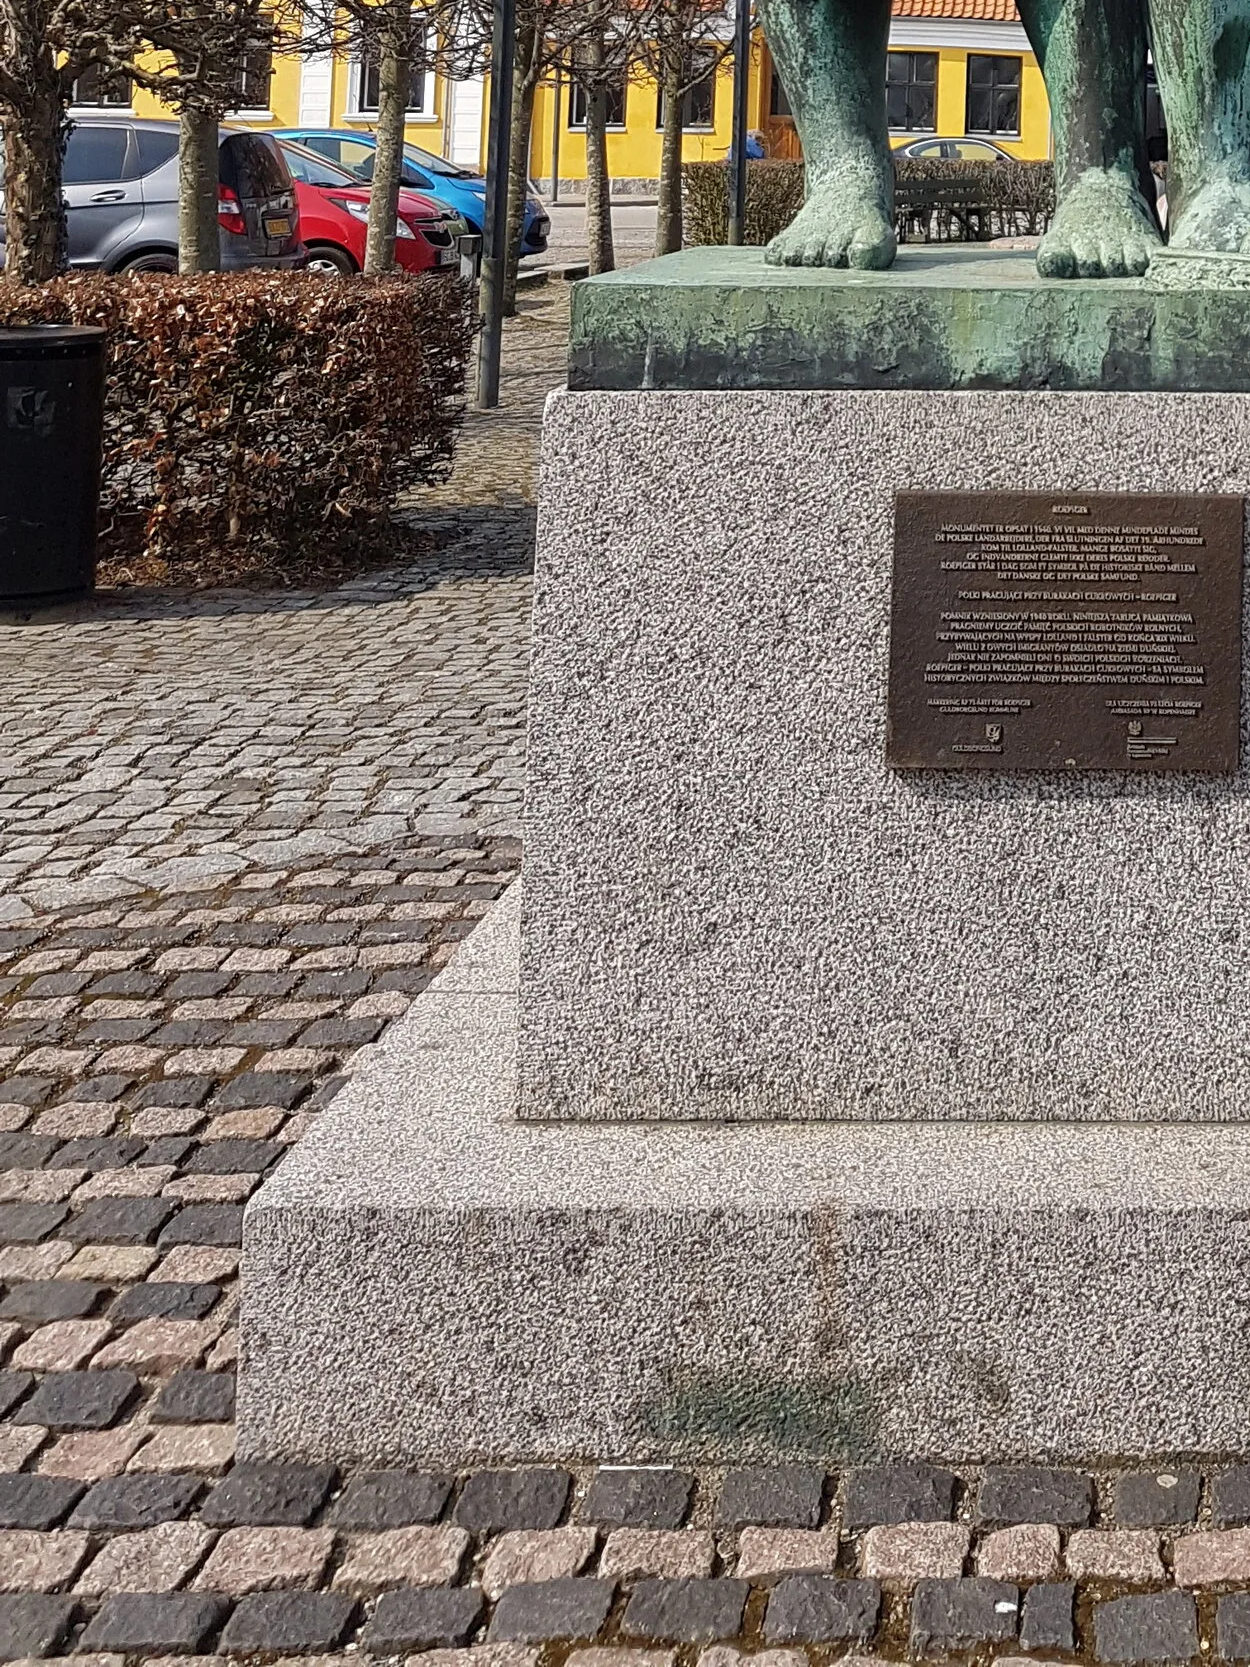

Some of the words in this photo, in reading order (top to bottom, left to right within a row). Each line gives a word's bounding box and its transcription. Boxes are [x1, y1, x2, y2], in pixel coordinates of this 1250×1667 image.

[941, 524, 994, 532] MONUMENTET
[1095, 526, 1120, 534] DENNE
[1170, 527, 1198, 535] MINDES
[1036, 535, 1050, 543] DER
[1126, 536, 1139, 544] DET
[1080, 545, 1108, 553] MANGE
[1110, 554, 1136, 562] POLSKE
[978, 561, 996, 570] STÅR
[1145, 563, 1166, 572] BÅND
[959, 591, 980, 599] POLKI
[1043, 592, 1083, 600] BURAKACH
[972, 613, 1020, 621] WZNIESIONY
[1090, 623, 1143, 631] ROBOTNIKÓW
[1017, 633, 1041, 641] WYSPY
[987, 643, 1016, 651] OWYCH
[948, 653, 976, 661] JEDNAK
[1062, 654, 1094, 662] SWOICH
[1096, 665, 1146, 673] CUKROWYCH
